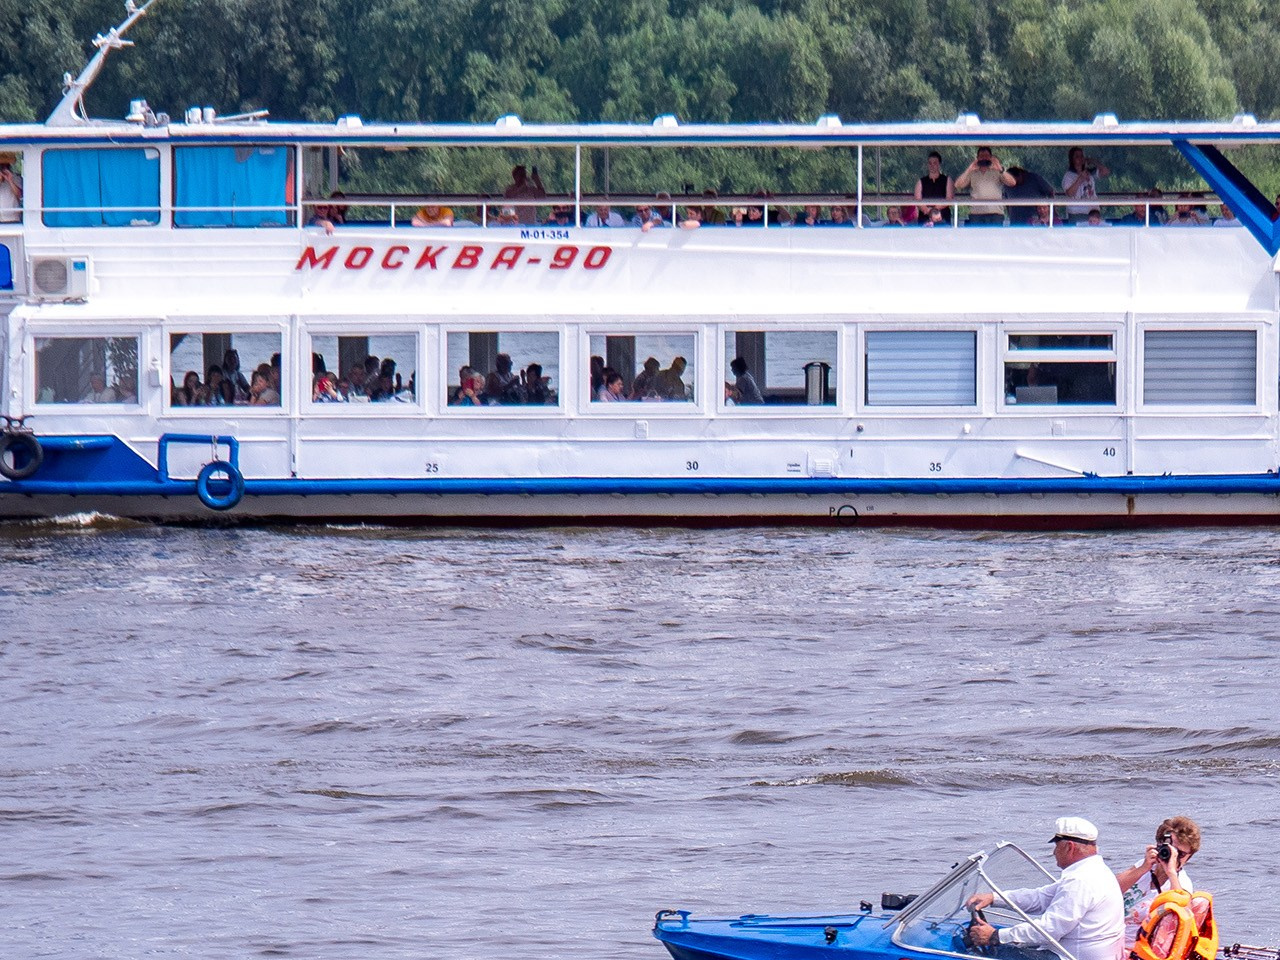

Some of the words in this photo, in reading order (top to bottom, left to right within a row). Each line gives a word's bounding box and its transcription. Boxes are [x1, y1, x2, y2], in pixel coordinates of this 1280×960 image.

[295, 245, 613, 271] МОСКВА-90
[1102, 447, 1116, 457] 40
[426, 463, 438, 473] 25
[686, 461, 699, 471] 30
[929, 462, 942, 472] 35
